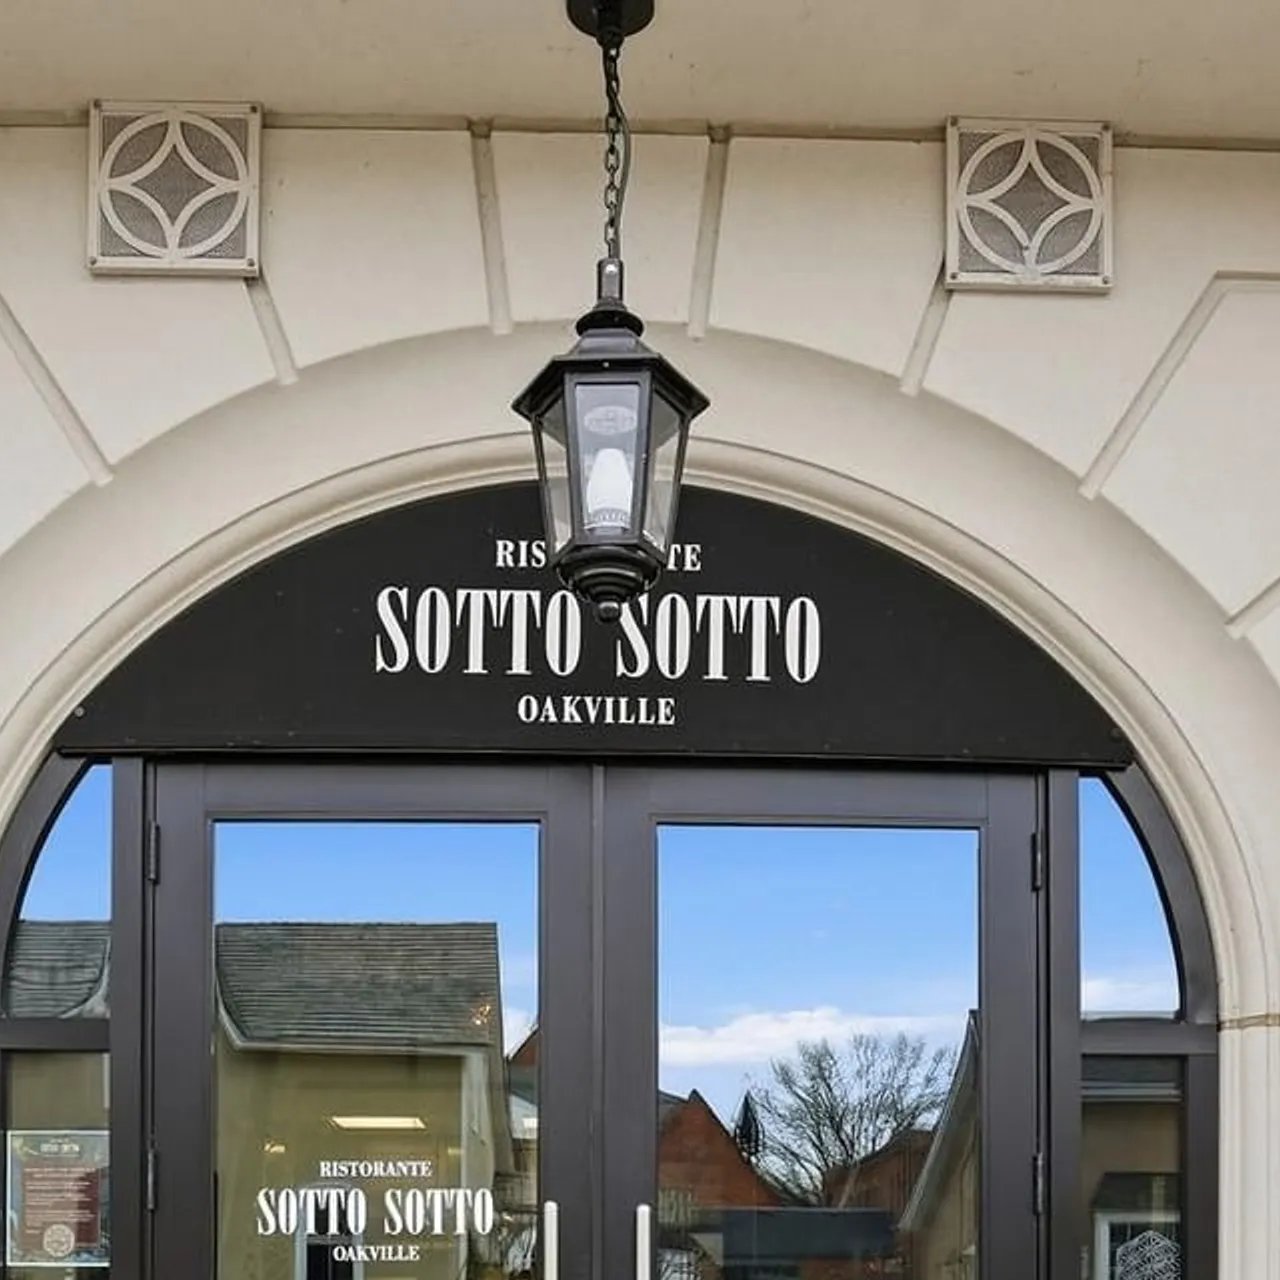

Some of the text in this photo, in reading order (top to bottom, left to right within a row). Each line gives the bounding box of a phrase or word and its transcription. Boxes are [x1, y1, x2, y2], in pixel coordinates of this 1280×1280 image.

[495, 539, 702, 571] RISTE
[375, 586, 821, 683] SOTTO SOTTO
[517, 695, 676, 725] OAKVILLE
[319, 1160, 433, 1177] RISTORANTE
[256, 1187, 495, 1236] SOTTO SOTTO
[332, 1245, 421, 1262] OAKVILLE
